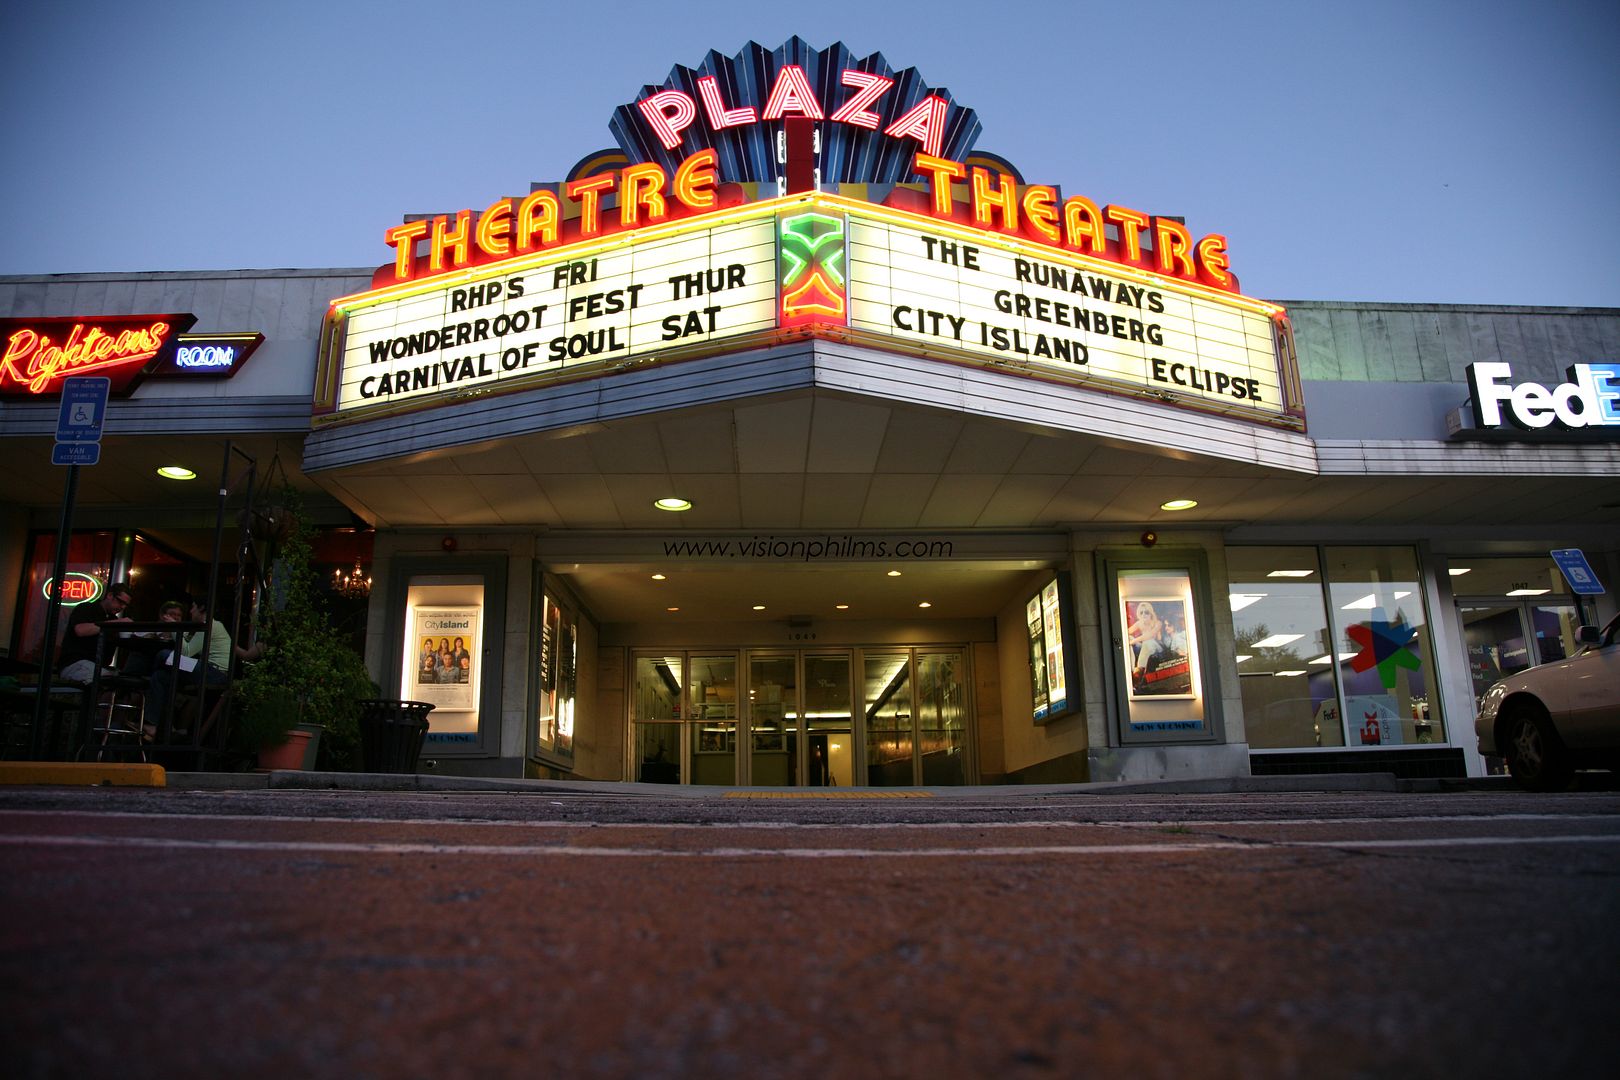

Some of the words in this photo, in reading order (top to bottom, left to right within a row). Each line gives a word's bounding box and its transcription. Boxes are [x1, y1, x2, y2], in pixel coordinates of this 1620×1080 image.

[638, 65, 947, 158] PLAZA
[386, 148, 719, 282] THEATRE
[913, 152, 1230, 286] THEATRE
[452, 276, 524, 313] RHPS
[553, 258, 598, 290] FRI
[922, 236, 980, 271] THE
[1015, 257, 1164, 314] RUNAWAYS
[369, 305, 548, 364] WONDERROOT
[569, 284, 643, 322] FEST
[669, 263, 746, 301] THUR
[893, 305, 966, 341] CITY
[981, 321, 1089, 365] ISLAND
[994, 290, 1163, 346] GREENBERG
[0, 321, 169, 394] Righteous
[176, 345, 234, 369] ROOM
[359, 352, 493, 398] CARNIVAL
[501, 343, 539, 371] OF
[549, 327, 625, 361] SOUL
[662, 306, 721, 341] SAT
[1152, 359, 1262, 401] ECLIPSE
[69, 447, 85, 455] VAN
[1512, 582, 1528, 590] 1047
